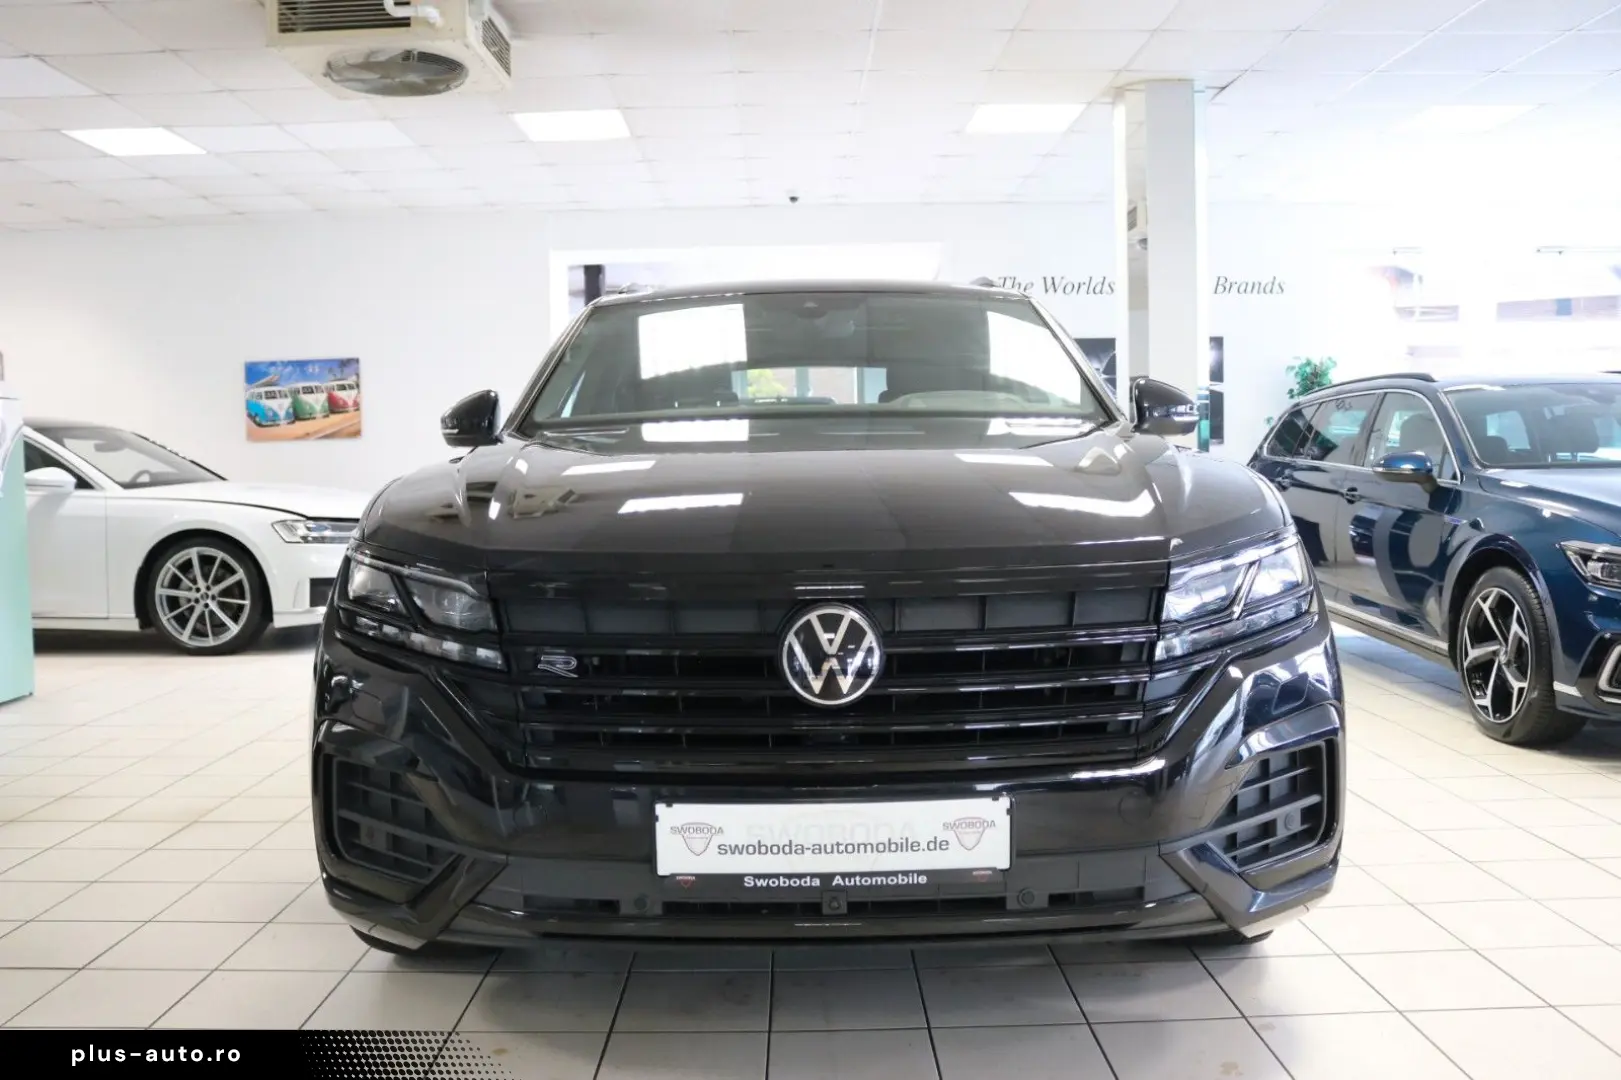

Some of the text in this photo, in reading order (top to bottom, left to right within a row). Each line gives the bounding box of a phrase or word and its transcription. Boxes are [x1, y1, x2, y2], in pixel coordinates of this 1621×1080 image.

[1042, 275, 1116, 295] Worlds
[1213, 275, 1286, 295] Brands
[784, 607, 879, 702] VW
[670, 826, 724, 835] SWOBODA
[942, 820, 996, 830] SWOBODA
[717, 836, 949, 856] swoboda-automobile.de
[743, 871, 928, 888] Swoboda Automobile
